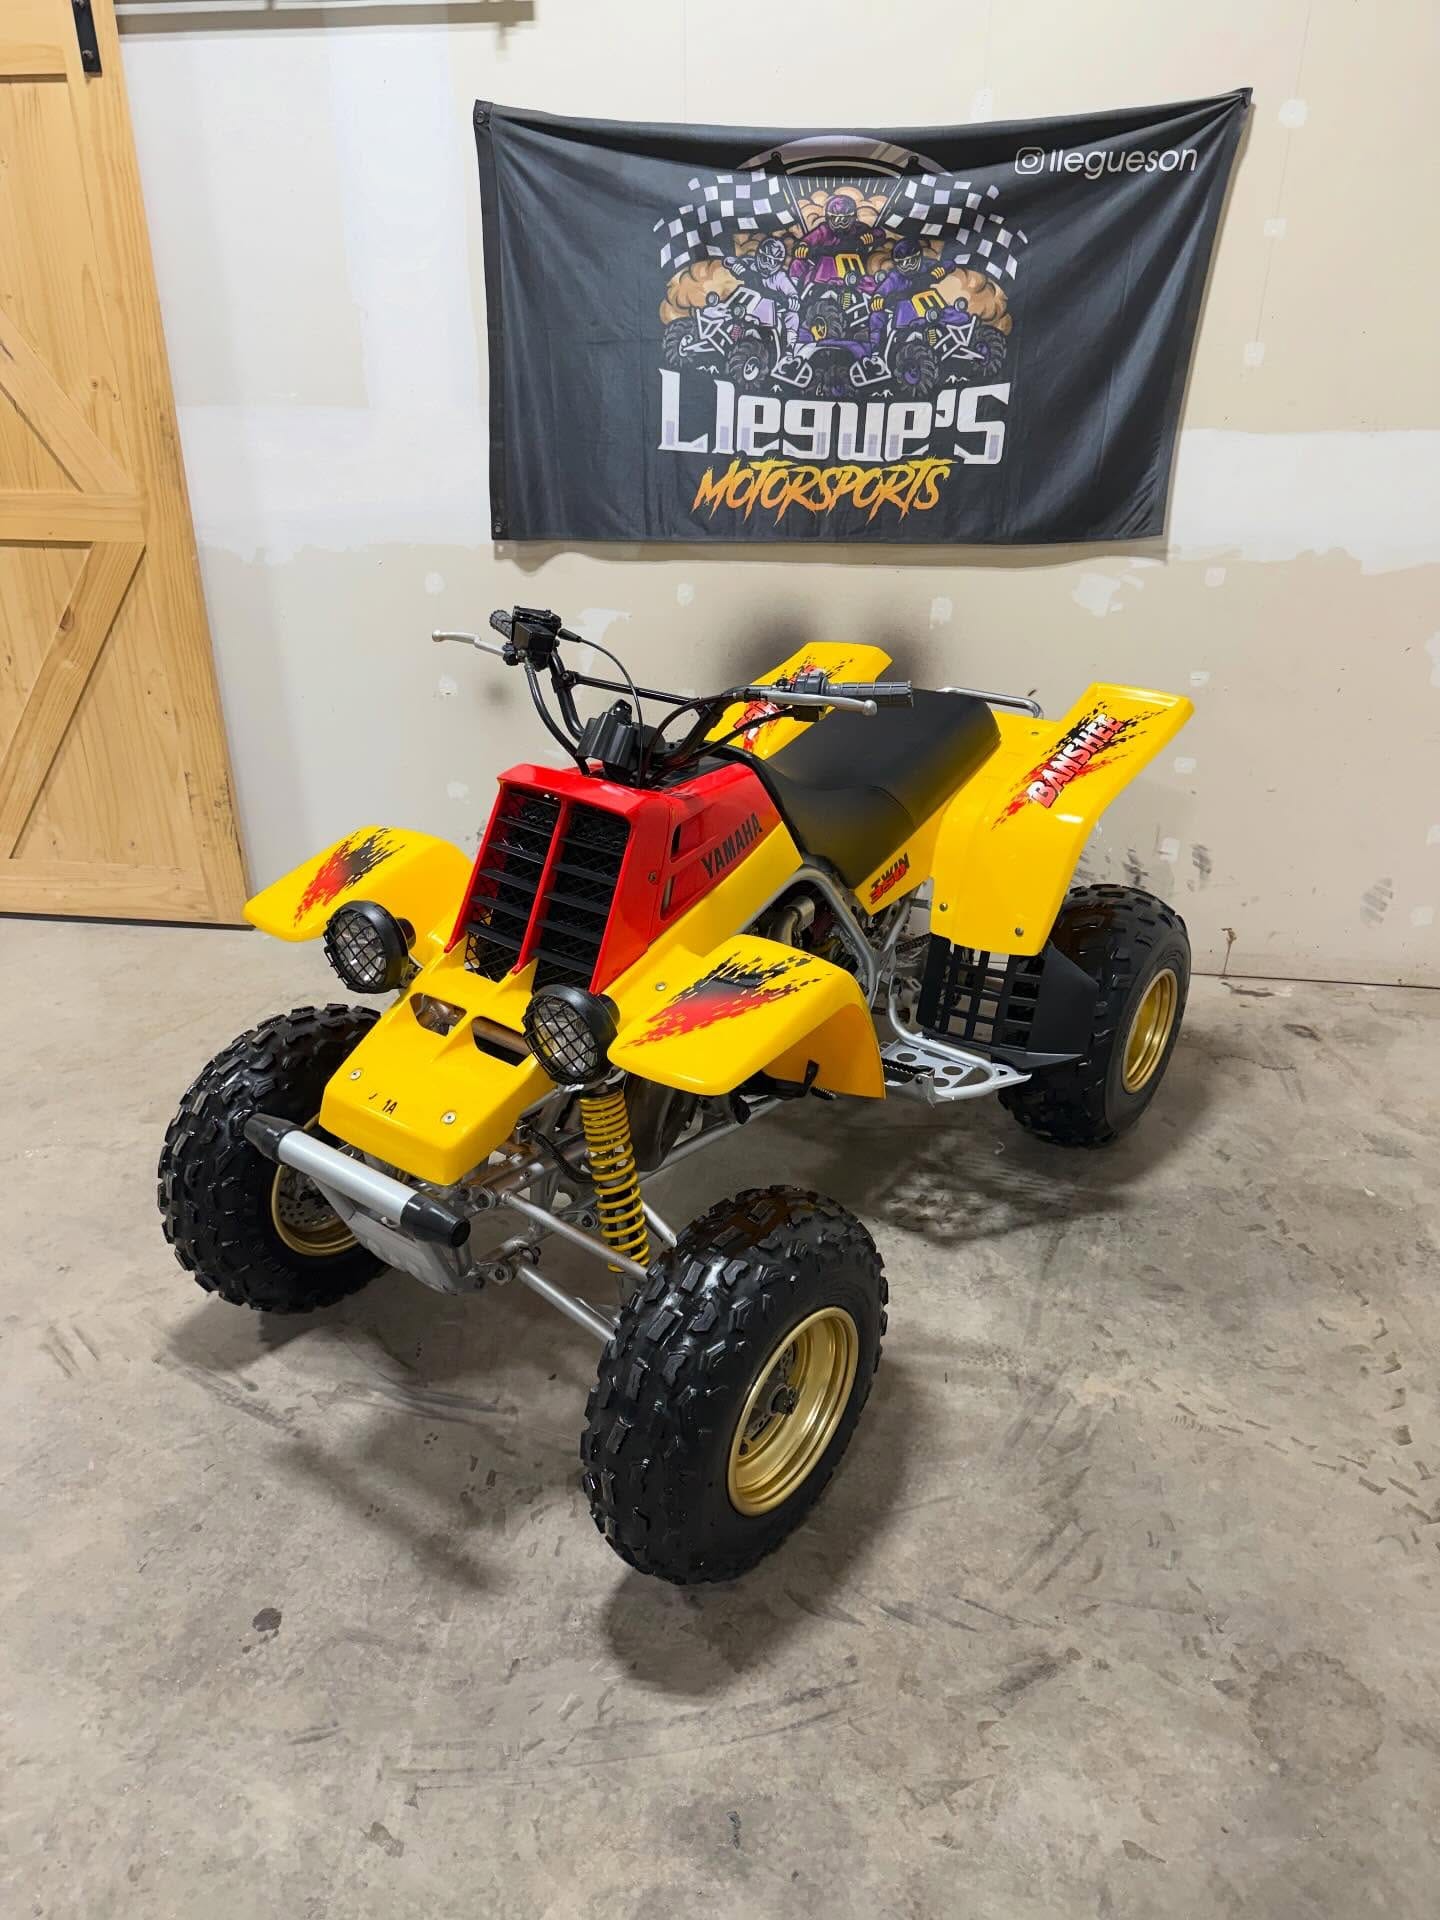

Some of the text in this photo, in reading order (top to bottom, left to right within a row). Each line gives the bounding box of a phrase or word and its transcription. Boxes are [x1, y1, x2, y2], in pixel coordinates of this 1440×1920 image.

[690, 456, 957, 527] MOTORSPORTS
[1026, 713, 1124, 808] BANSHEE
[701, 812, 763, 879] YAMAHA
[871, 852, 910, 890] TWIN
